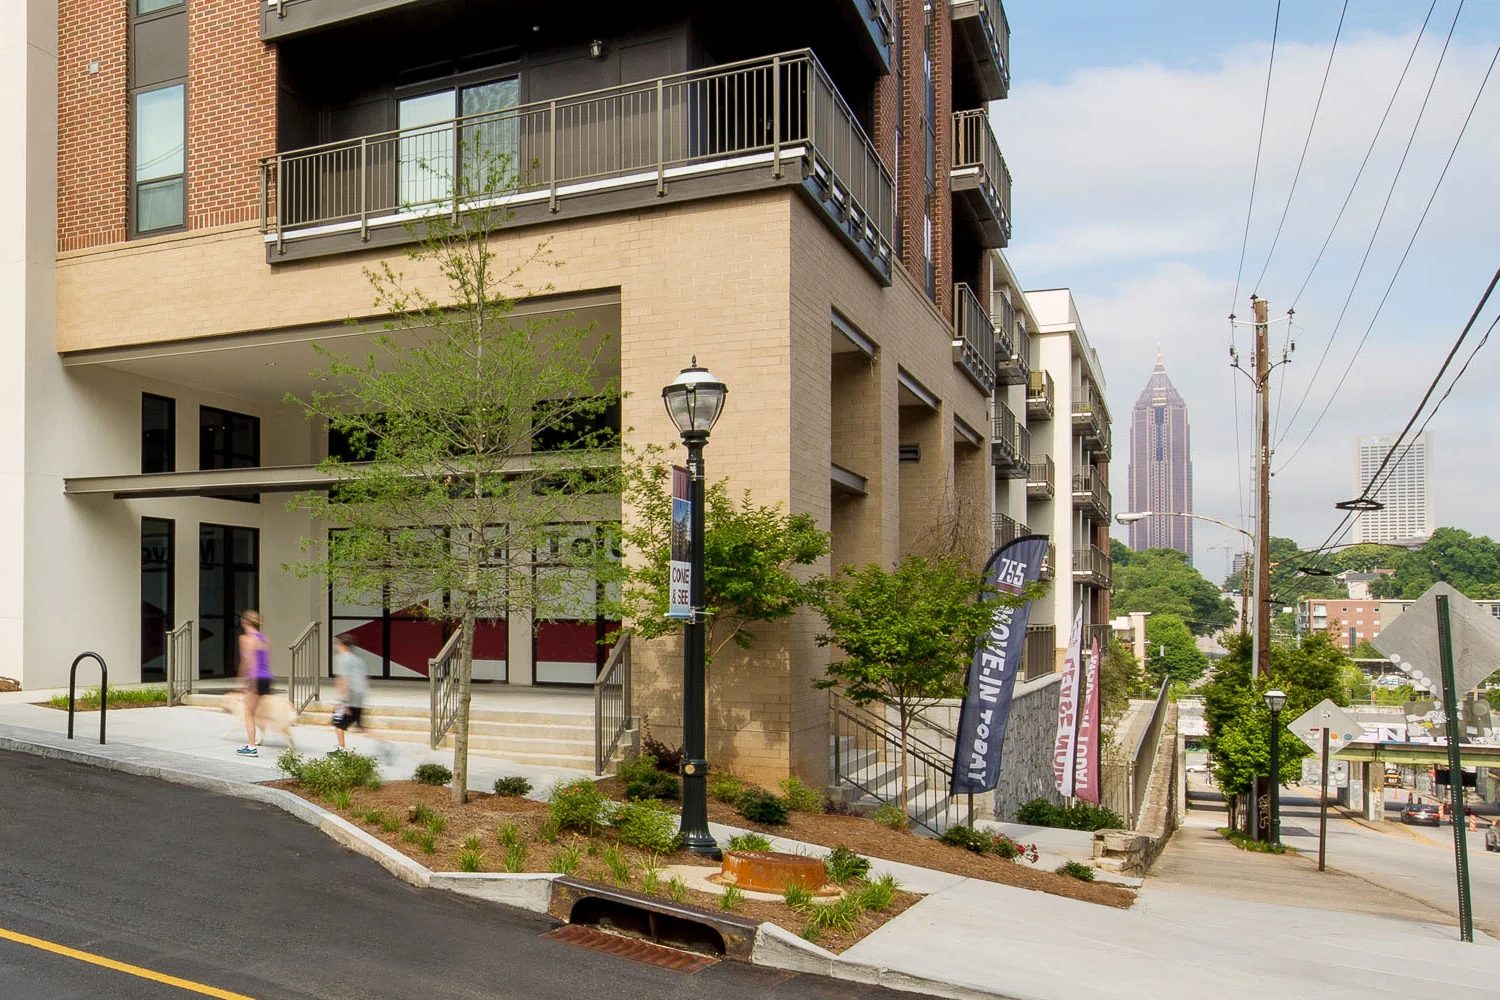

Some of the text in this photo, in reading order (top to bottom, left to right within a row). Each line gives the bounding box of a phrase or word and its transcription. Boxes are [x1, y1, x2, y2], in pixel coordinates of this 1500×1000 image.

[672, 566, 690, 584] COME
[998, 557, 1027, 586] 755
[678, 588, 689, 605] SEE
[968, 709, 993, 787] TODAY
